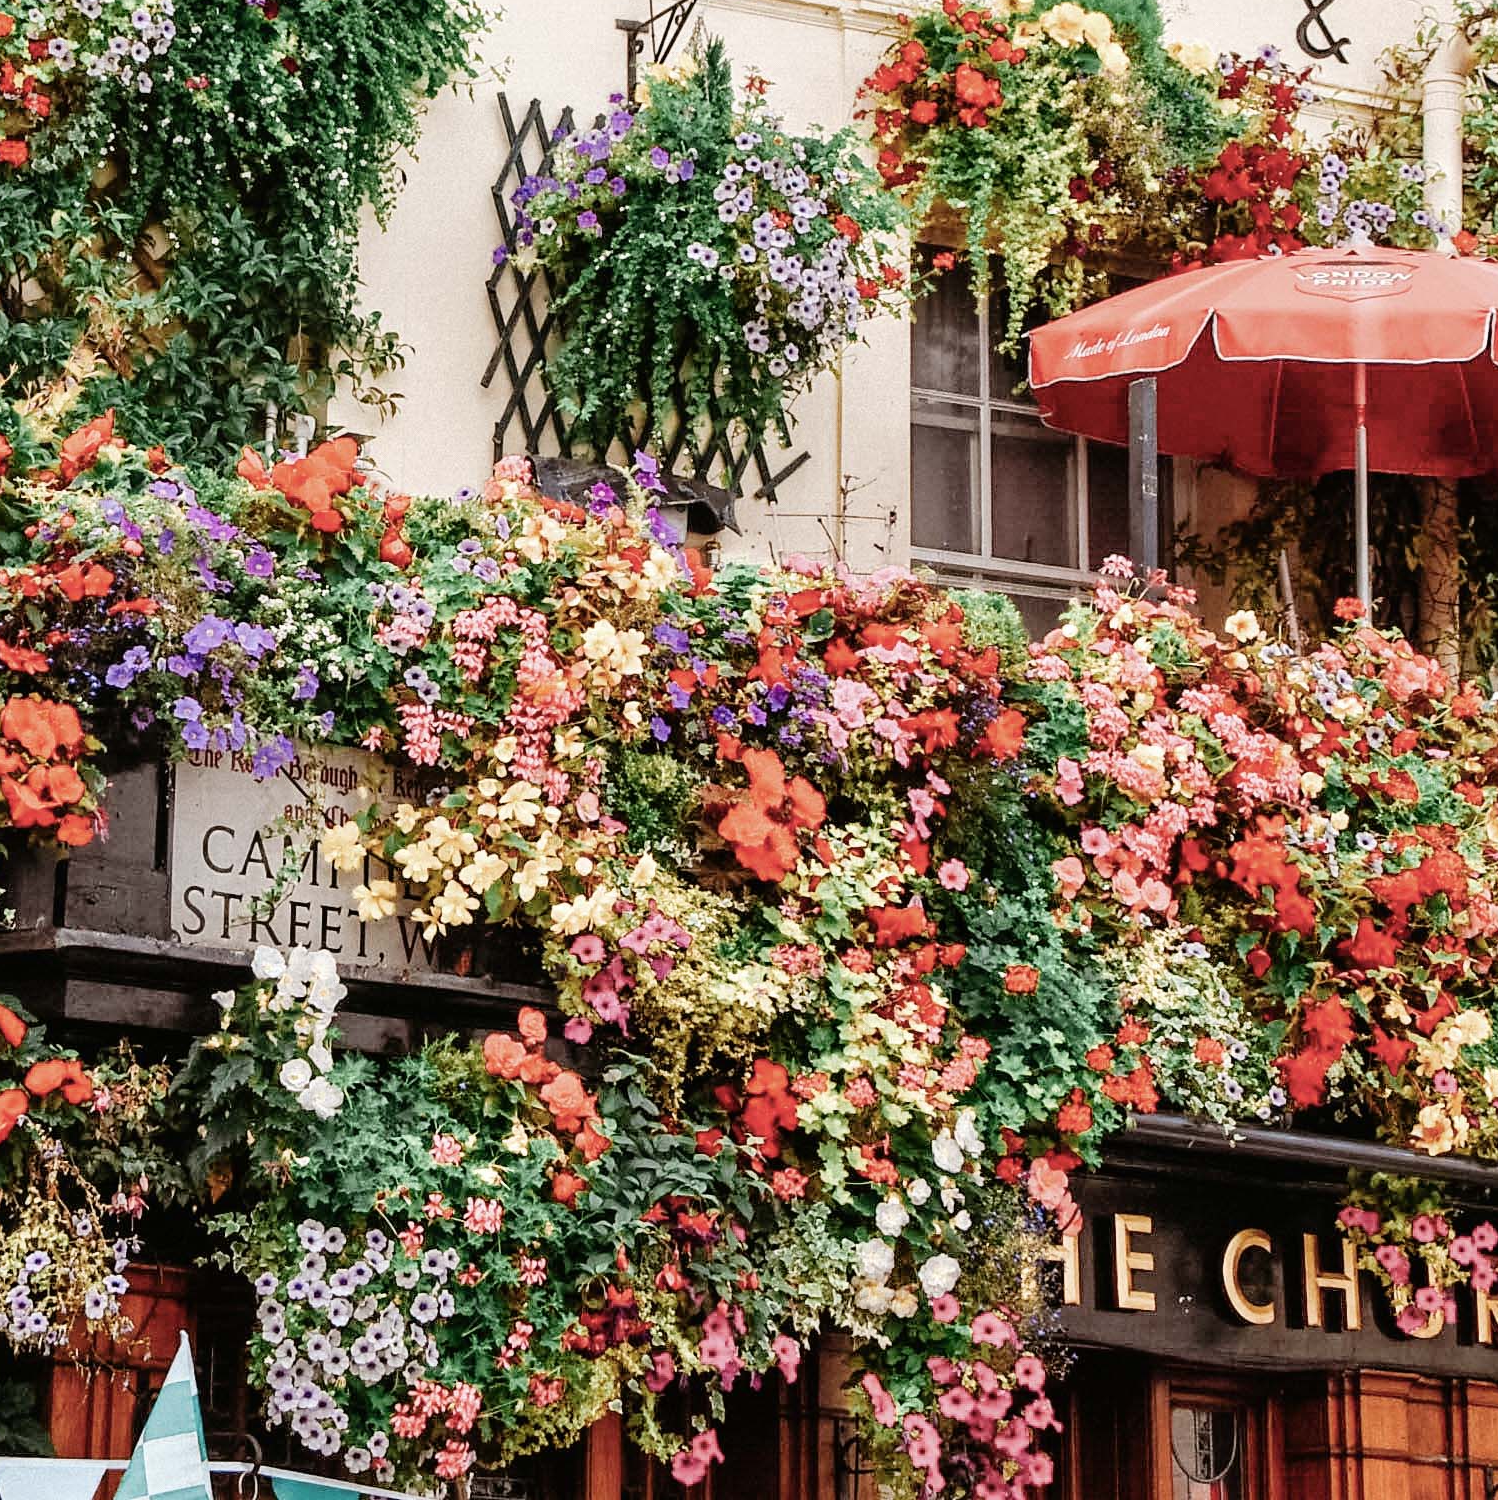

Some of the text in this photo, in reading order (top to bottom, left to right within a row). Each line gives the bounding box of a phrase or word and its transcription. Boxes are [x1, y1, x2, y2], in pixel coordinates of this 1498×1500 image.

[1295, 270, 1413, 280] LONDON
[1313, 278, 1395, 286] PRIDE
[1063, 323, 1172, 359] Made of London
[288, 754, 358, 795] Boough
[182, 885, 385, 962] STREET,
[1017, 1212, 1158, 1312] HE
